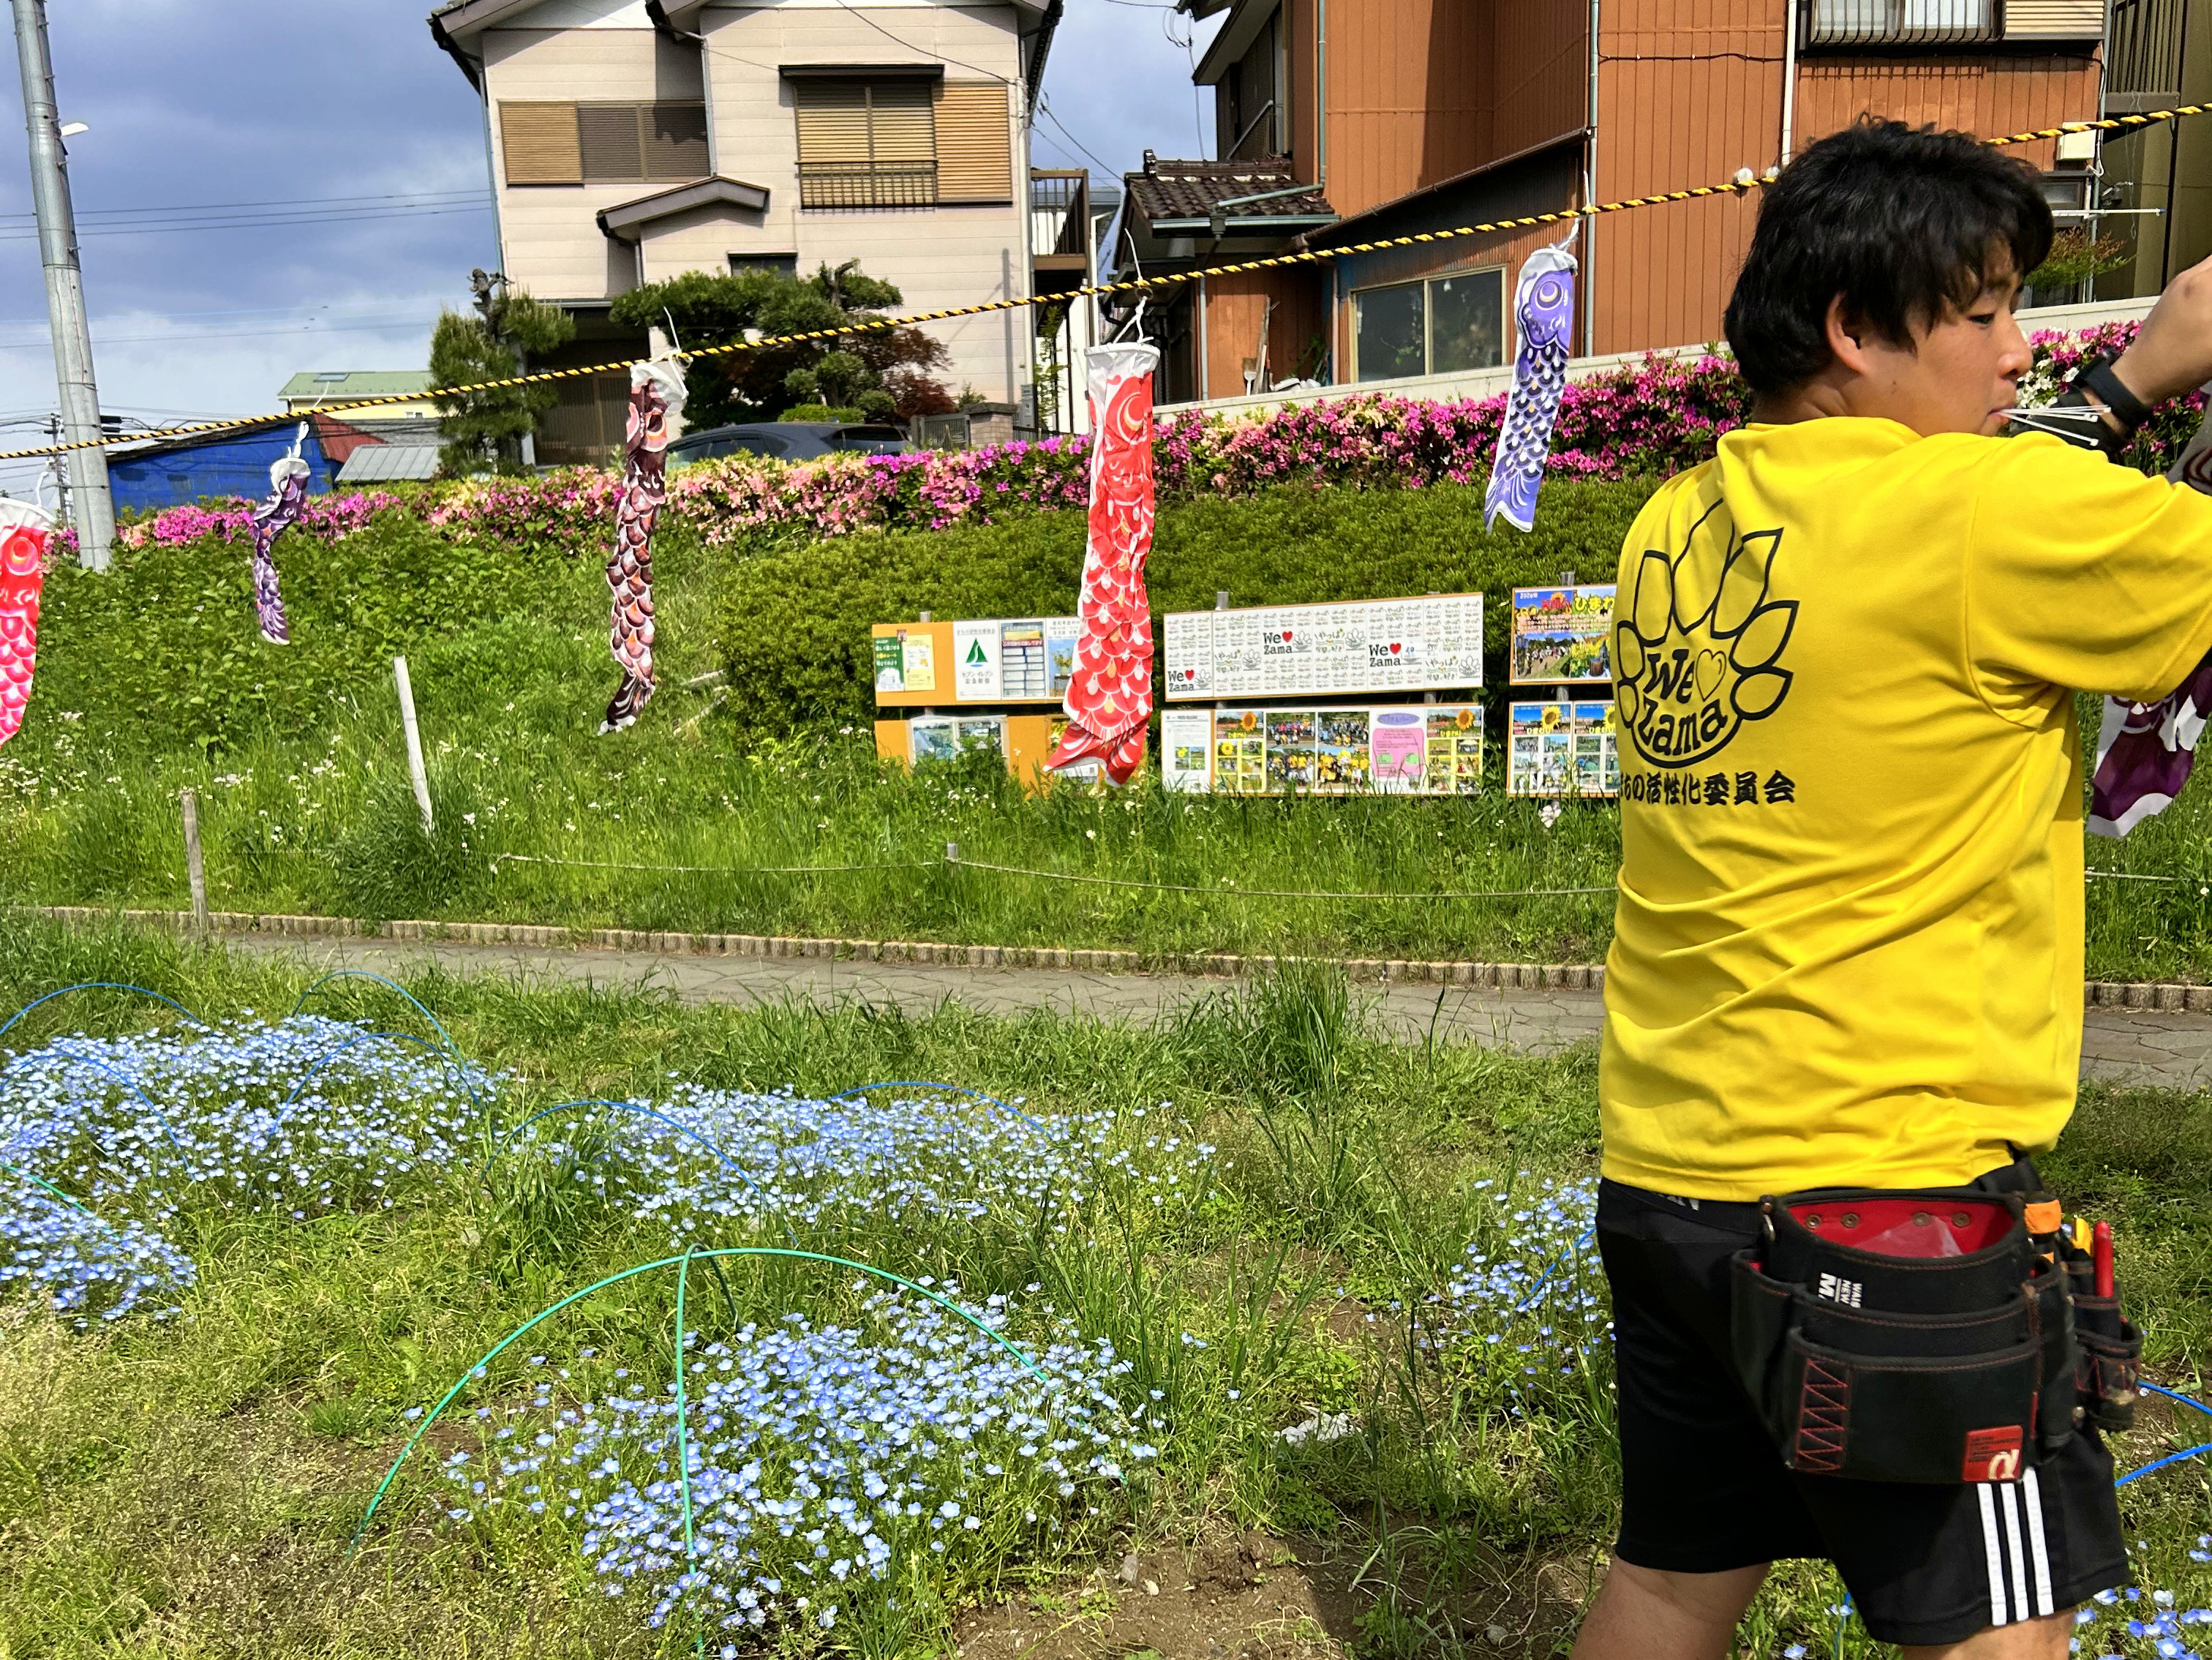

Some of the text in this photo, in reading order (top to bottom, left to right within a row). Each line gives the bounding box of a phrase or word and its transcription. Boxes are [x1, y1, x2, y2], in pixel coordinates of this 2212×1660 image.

[1263, 632, 1281, 645] We
[1263, 645, 1293, 655] Zama
[1369, 644, 1388, 656] We
[1369, 657, 1402, 667] Zama
[1168, 670, 1184, 682] We
[1643, 649, 1695, 704] We
[1168, 683, 1195, 692] Zama
[1638, 694, 1728, 756] Zama
[1818, 1272, 1836, 1300] M
[1840, 1280, 1851, 1304] NEW
